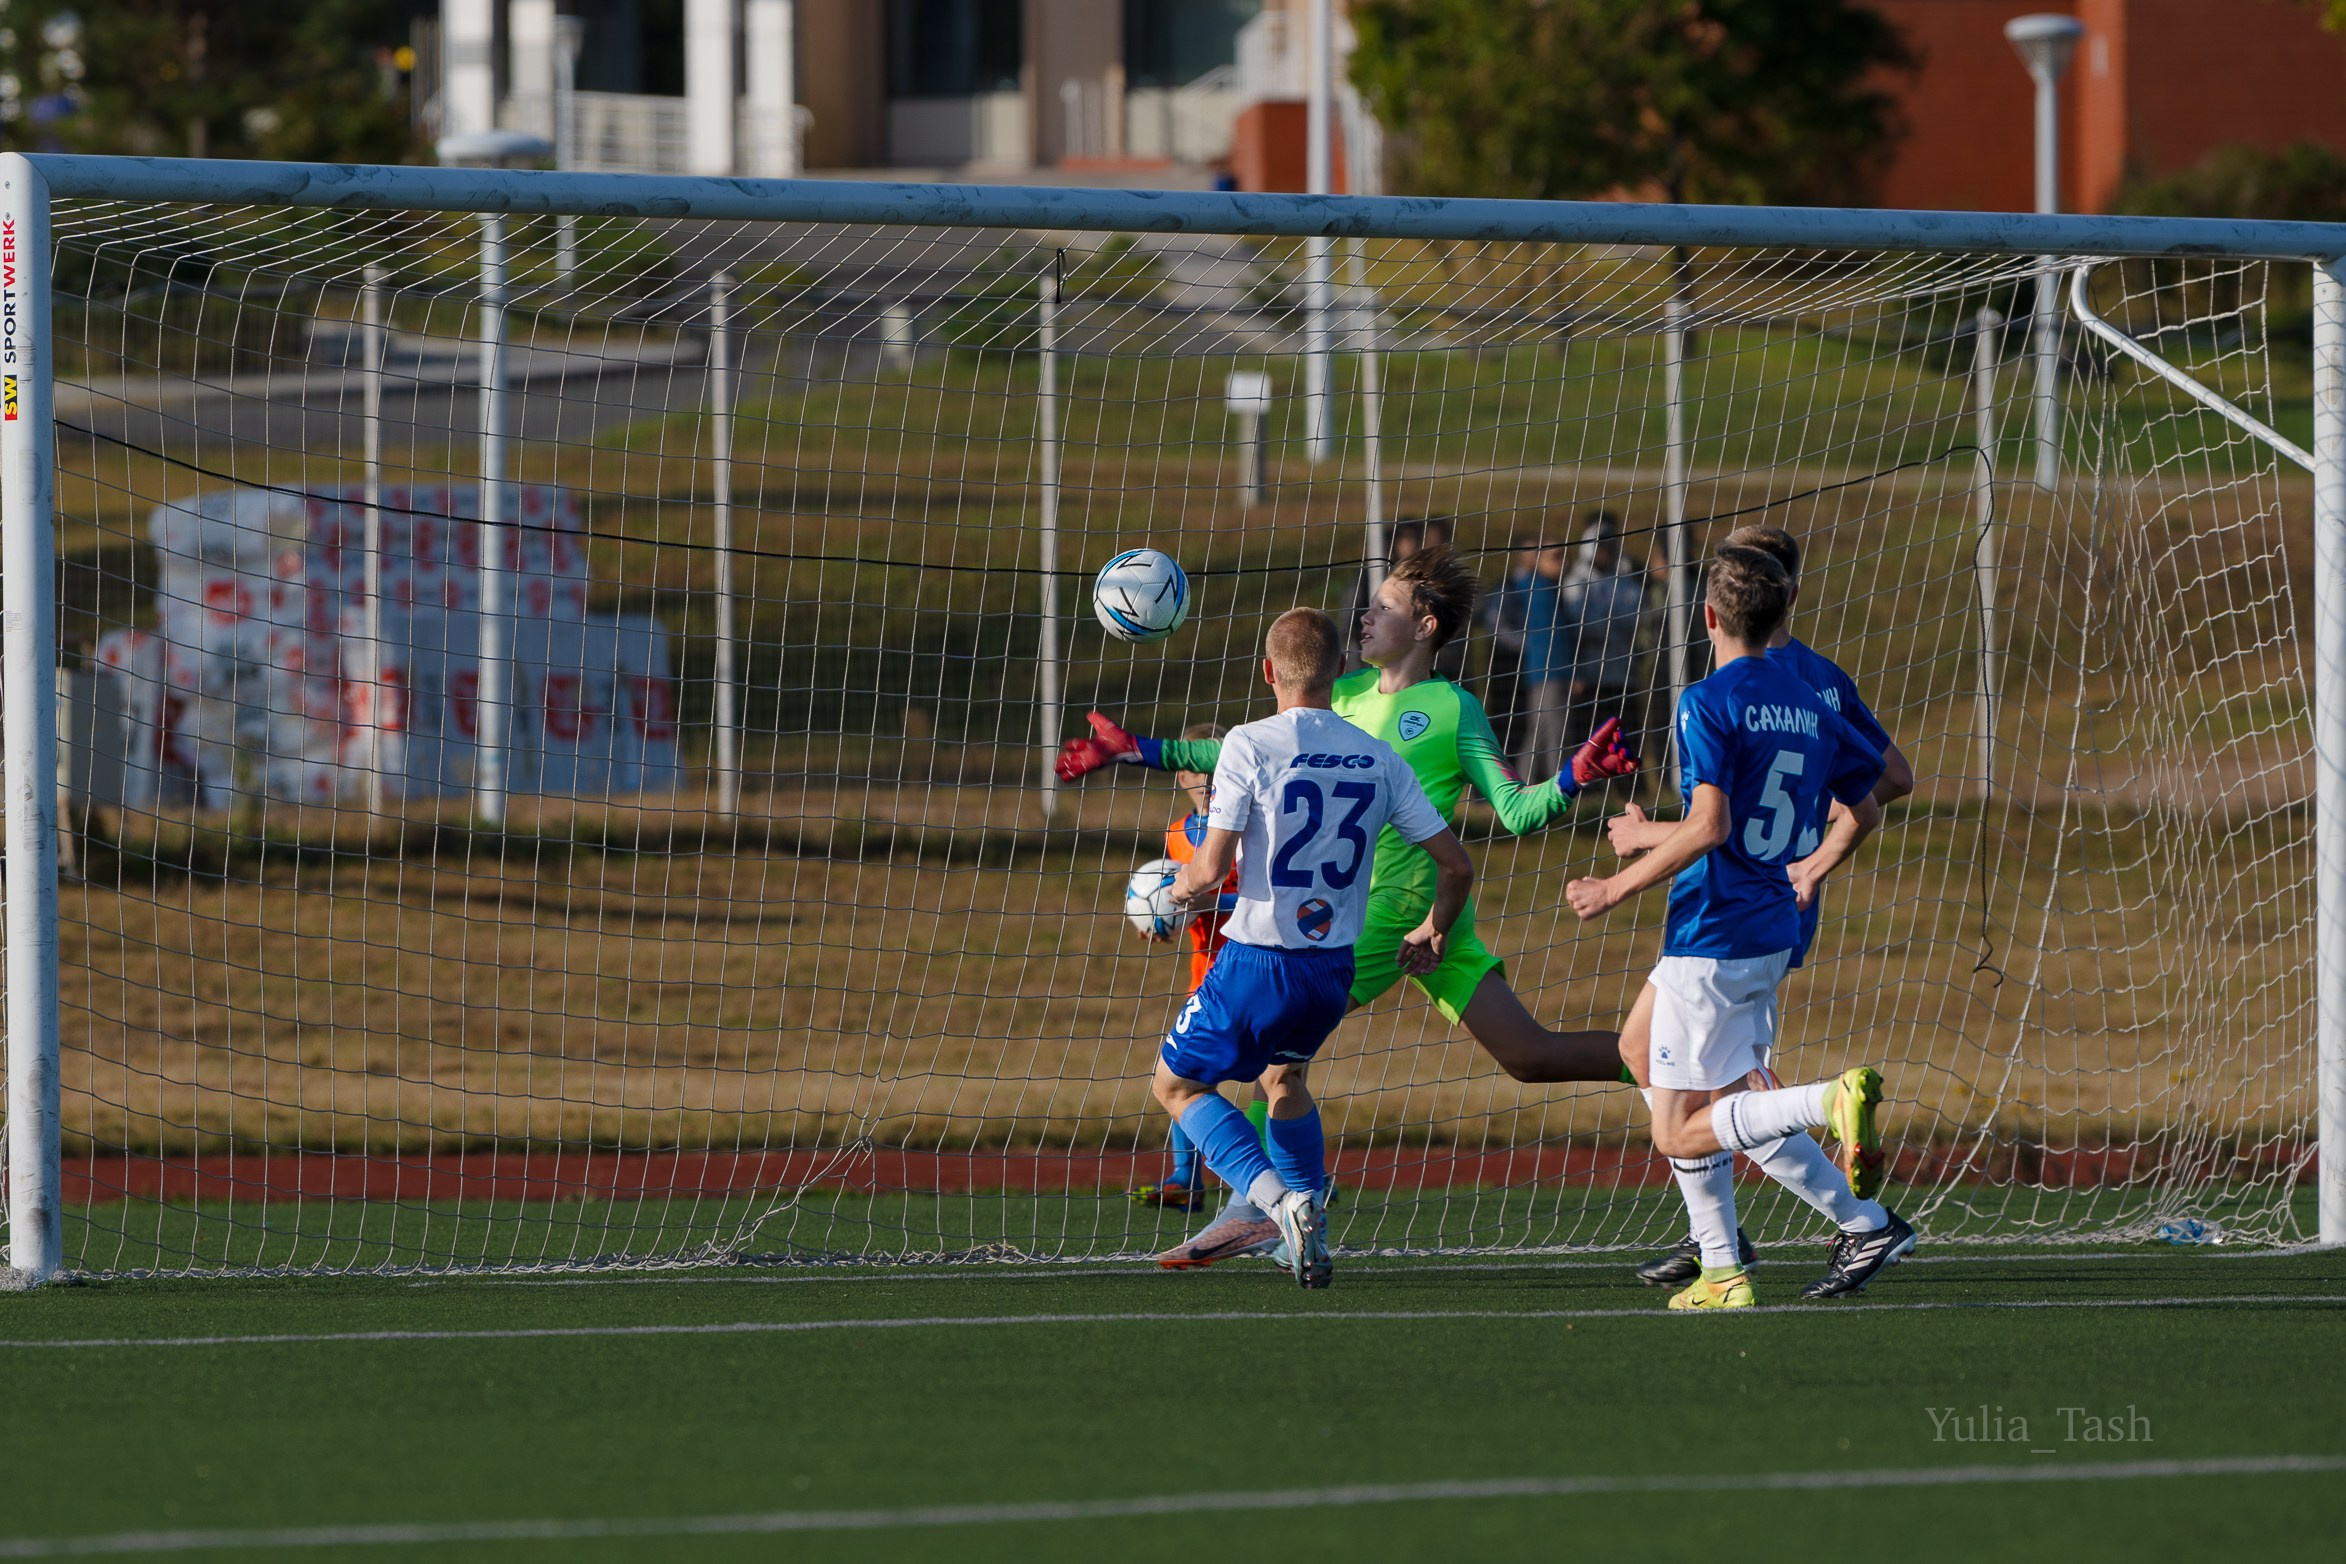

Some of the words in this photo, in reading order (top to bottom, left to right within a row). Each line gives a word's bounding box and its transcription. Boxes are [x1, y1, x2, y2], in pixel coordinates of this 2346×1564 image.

[3, 219, 16, 363] SPORTWERK
[4, 377, 17, 415] SW
[1745, 704, 1819, 740] САХАЛИН
[1289, 753, 1375, 769] FESCO
[1272, 779, 1376, 890] 23
[1743, 750, 1804, 861] 5
